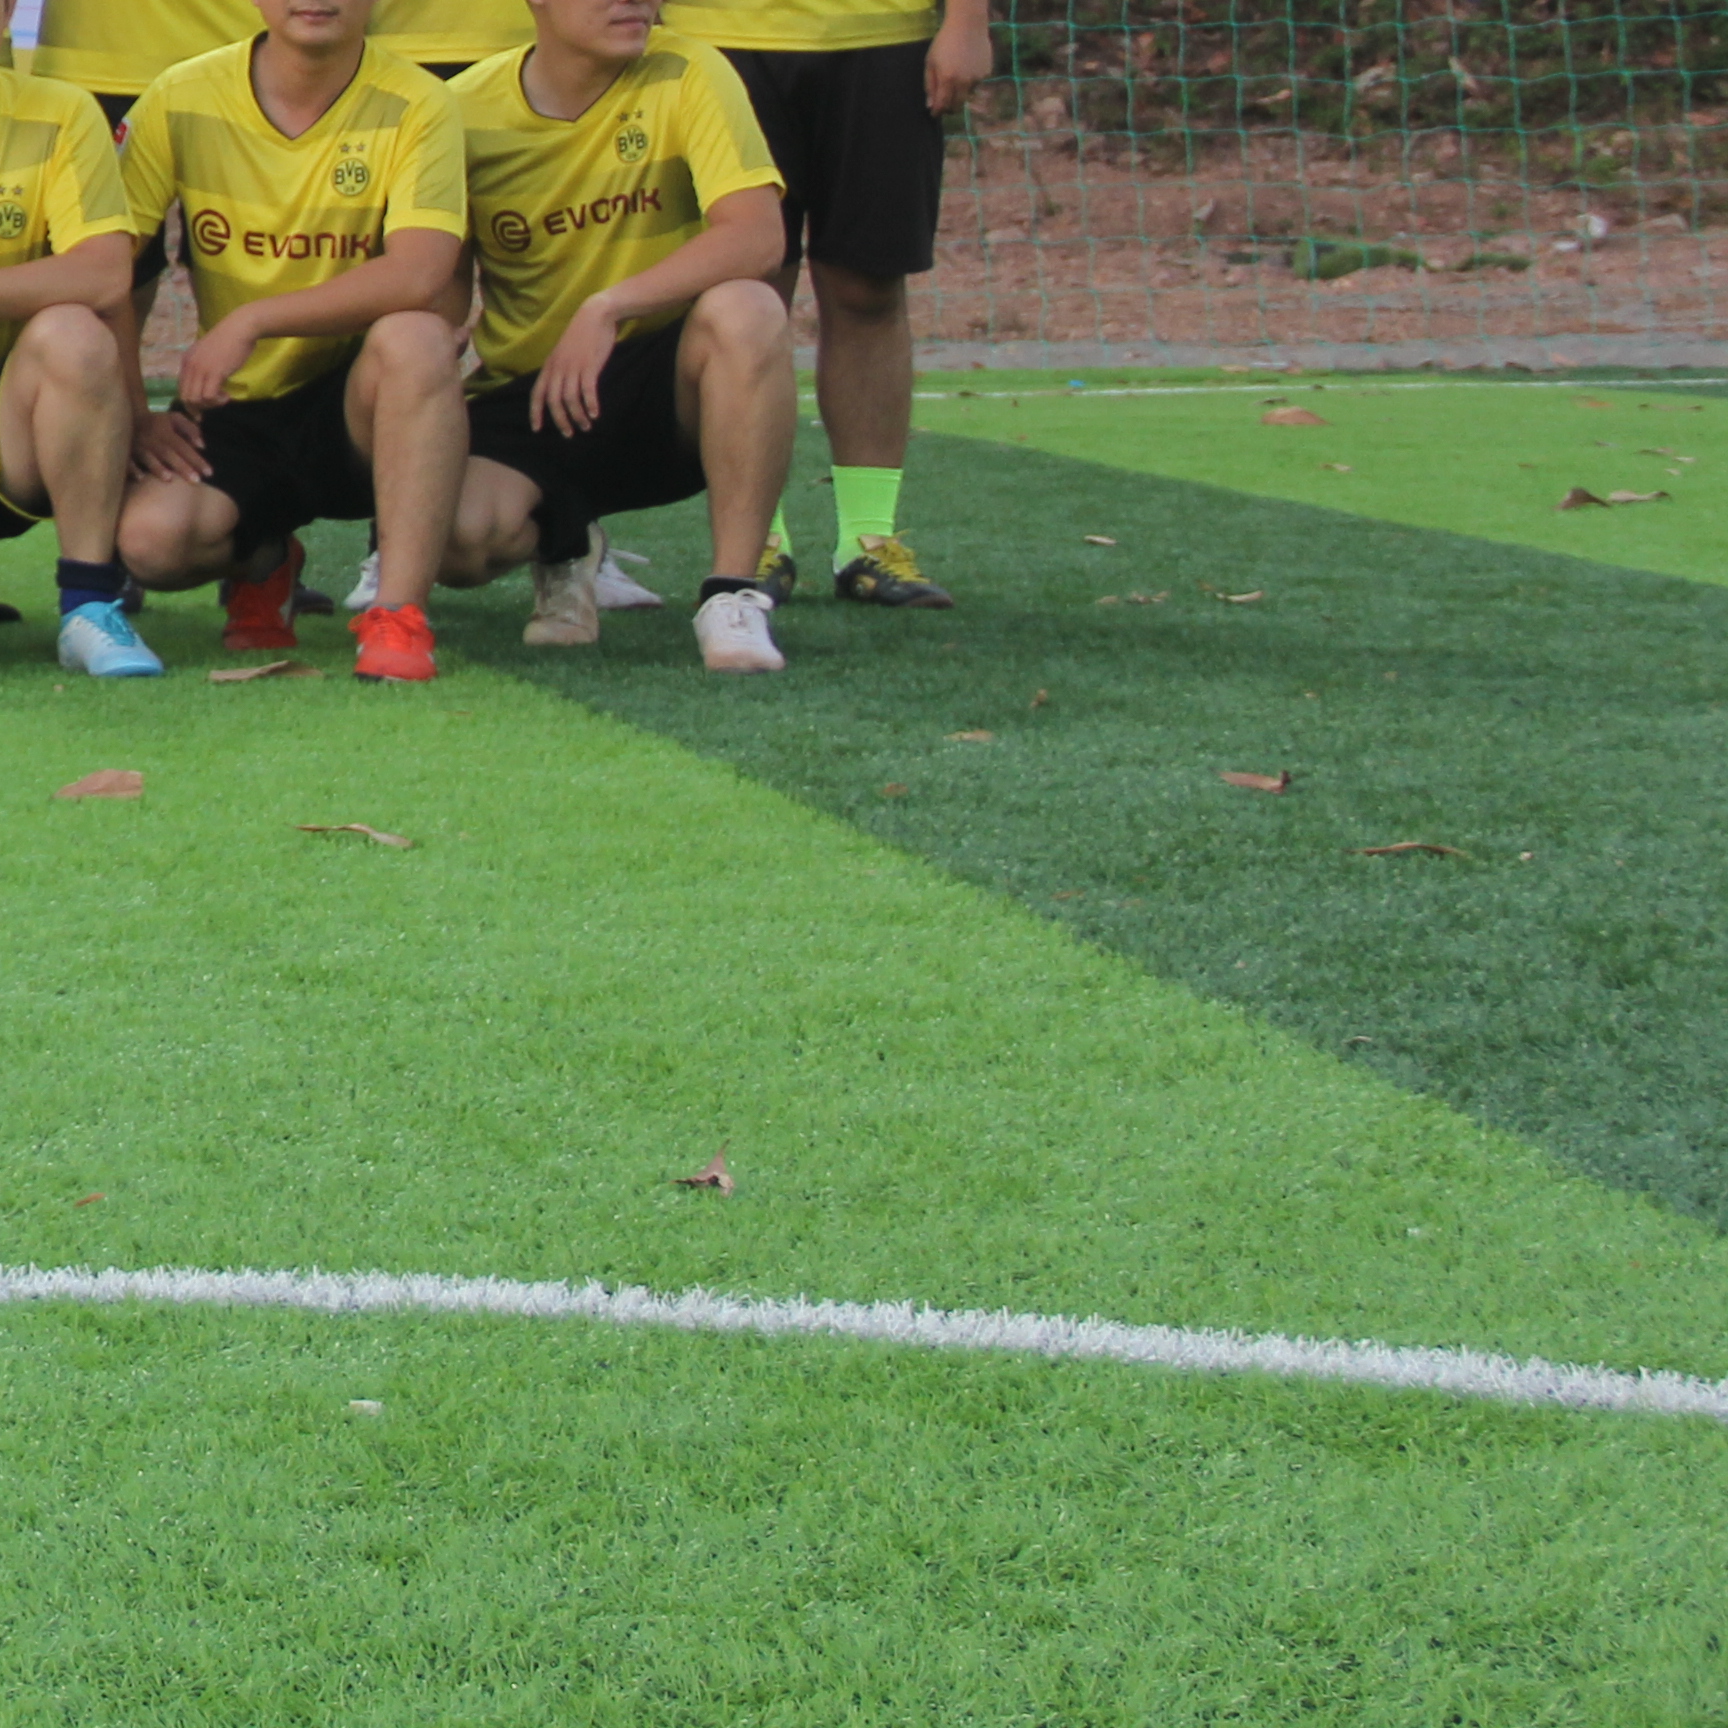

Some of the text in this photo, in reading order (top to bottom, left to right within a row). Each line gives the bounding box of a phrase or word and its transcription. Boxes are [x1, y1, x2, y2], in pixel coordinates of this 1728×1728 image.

[618, 128, 646, 153] BVB
[334, 163, 366, 185] BVB
[543, 188, 663, 237] EVONIK
[243, 230, 373, 259] EVONIK
